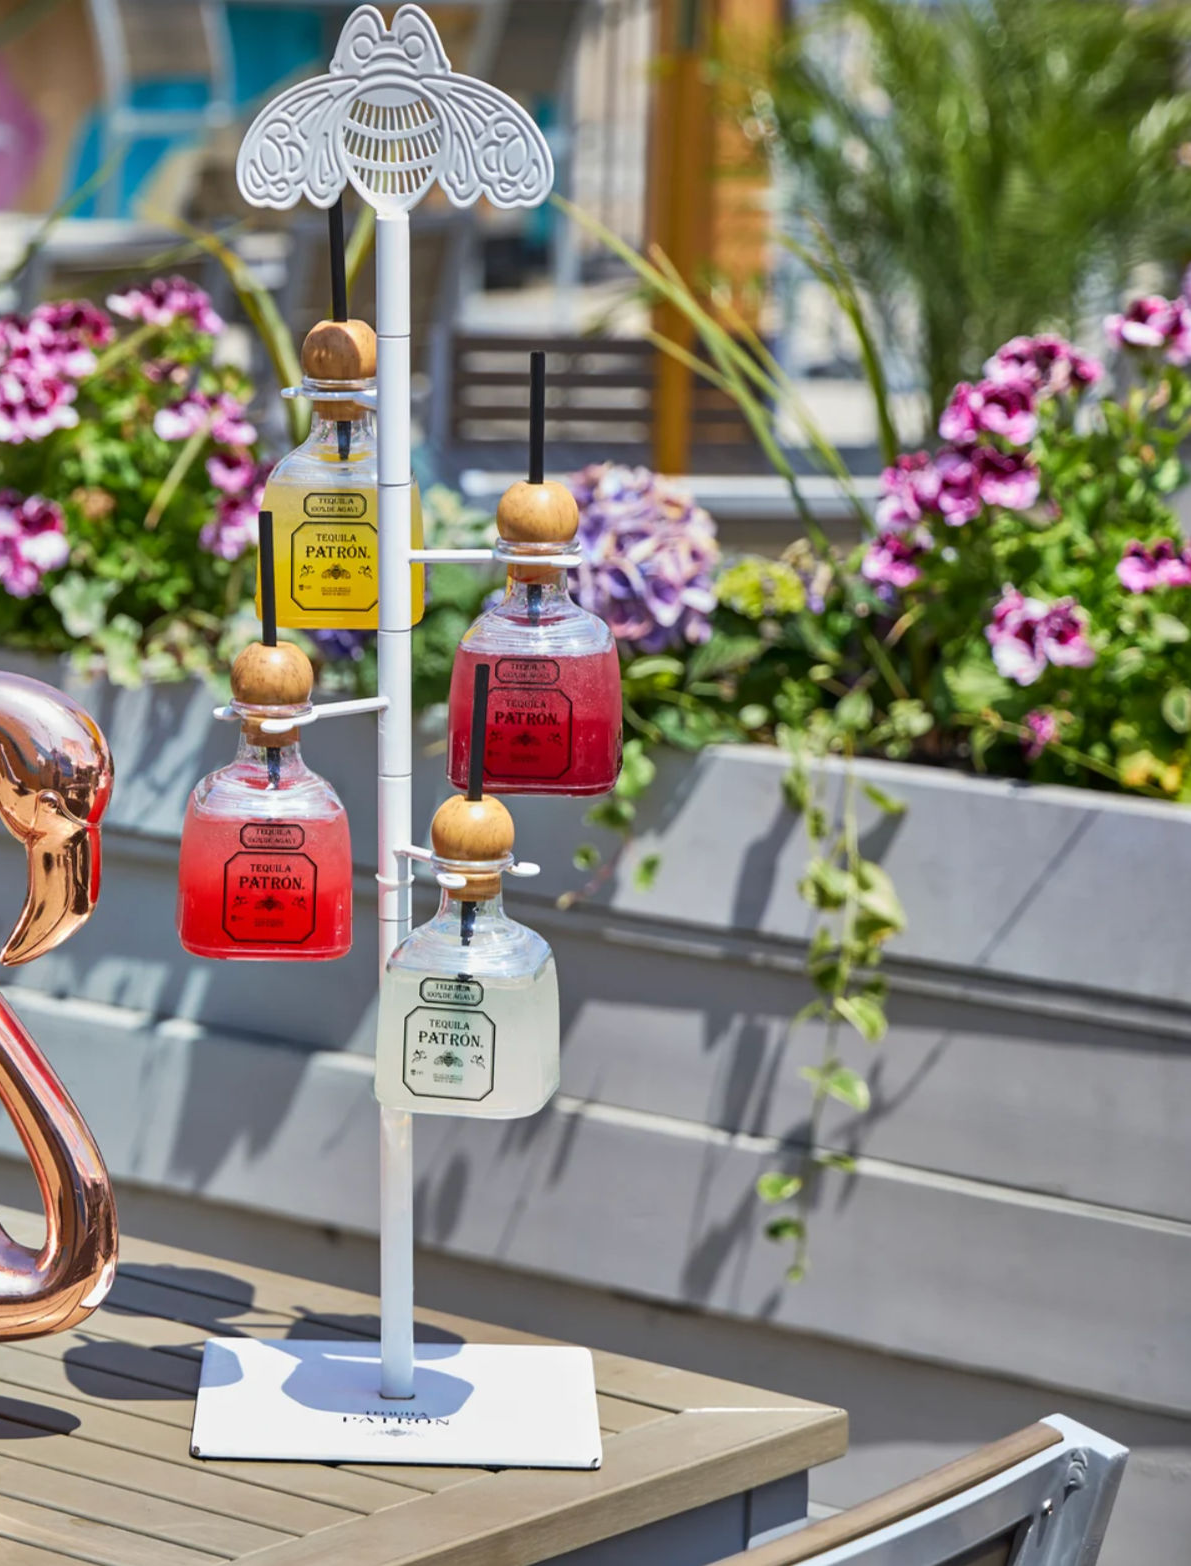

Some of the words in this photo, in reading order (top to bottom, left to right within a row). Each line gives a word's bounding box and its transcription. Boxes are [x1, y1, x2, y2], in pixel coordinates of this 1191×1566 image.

[316, 533, 357, 542] TEQUILA
[506, 699, 547, 709] TEQUILA
[250, 864, 291, 873] TEQUILA
[429, 1019, 470, 1030] TEQUILA
